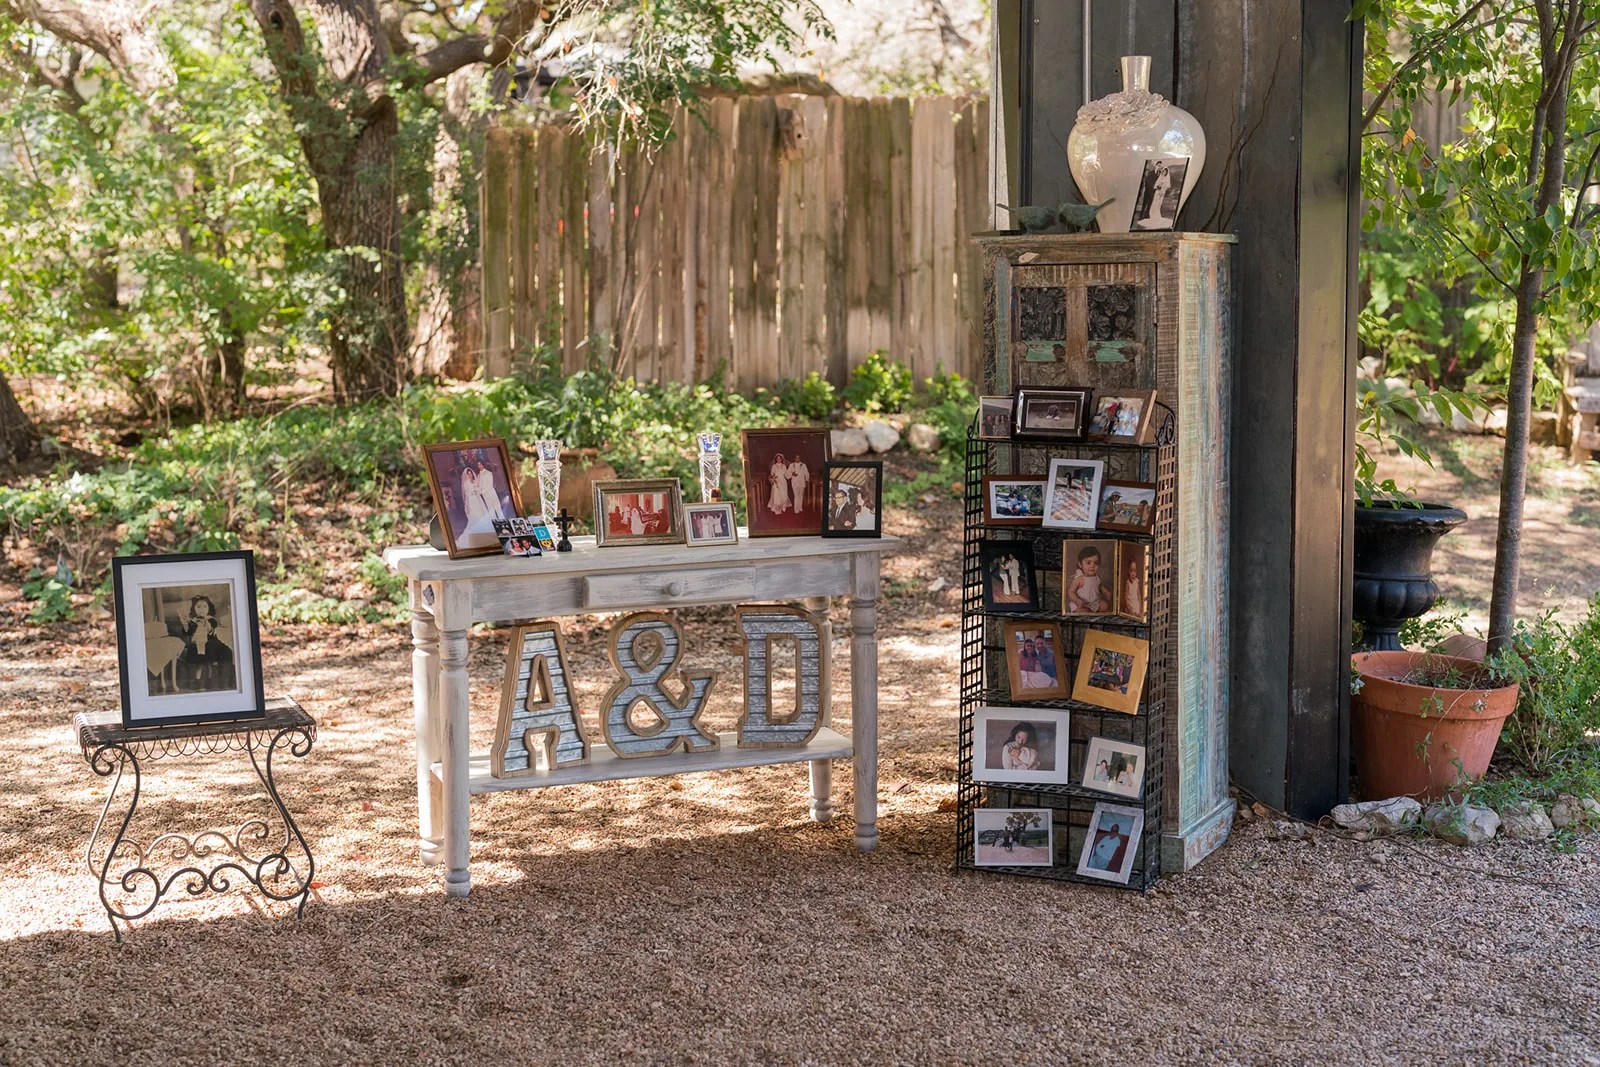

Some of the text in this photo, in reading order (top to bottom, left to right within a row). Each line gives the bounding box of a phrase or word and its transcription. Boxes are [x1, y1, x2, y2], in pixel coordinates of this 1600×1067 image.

[538, 529, 546, 537] D
[491, 605, 825, 778] A & D
